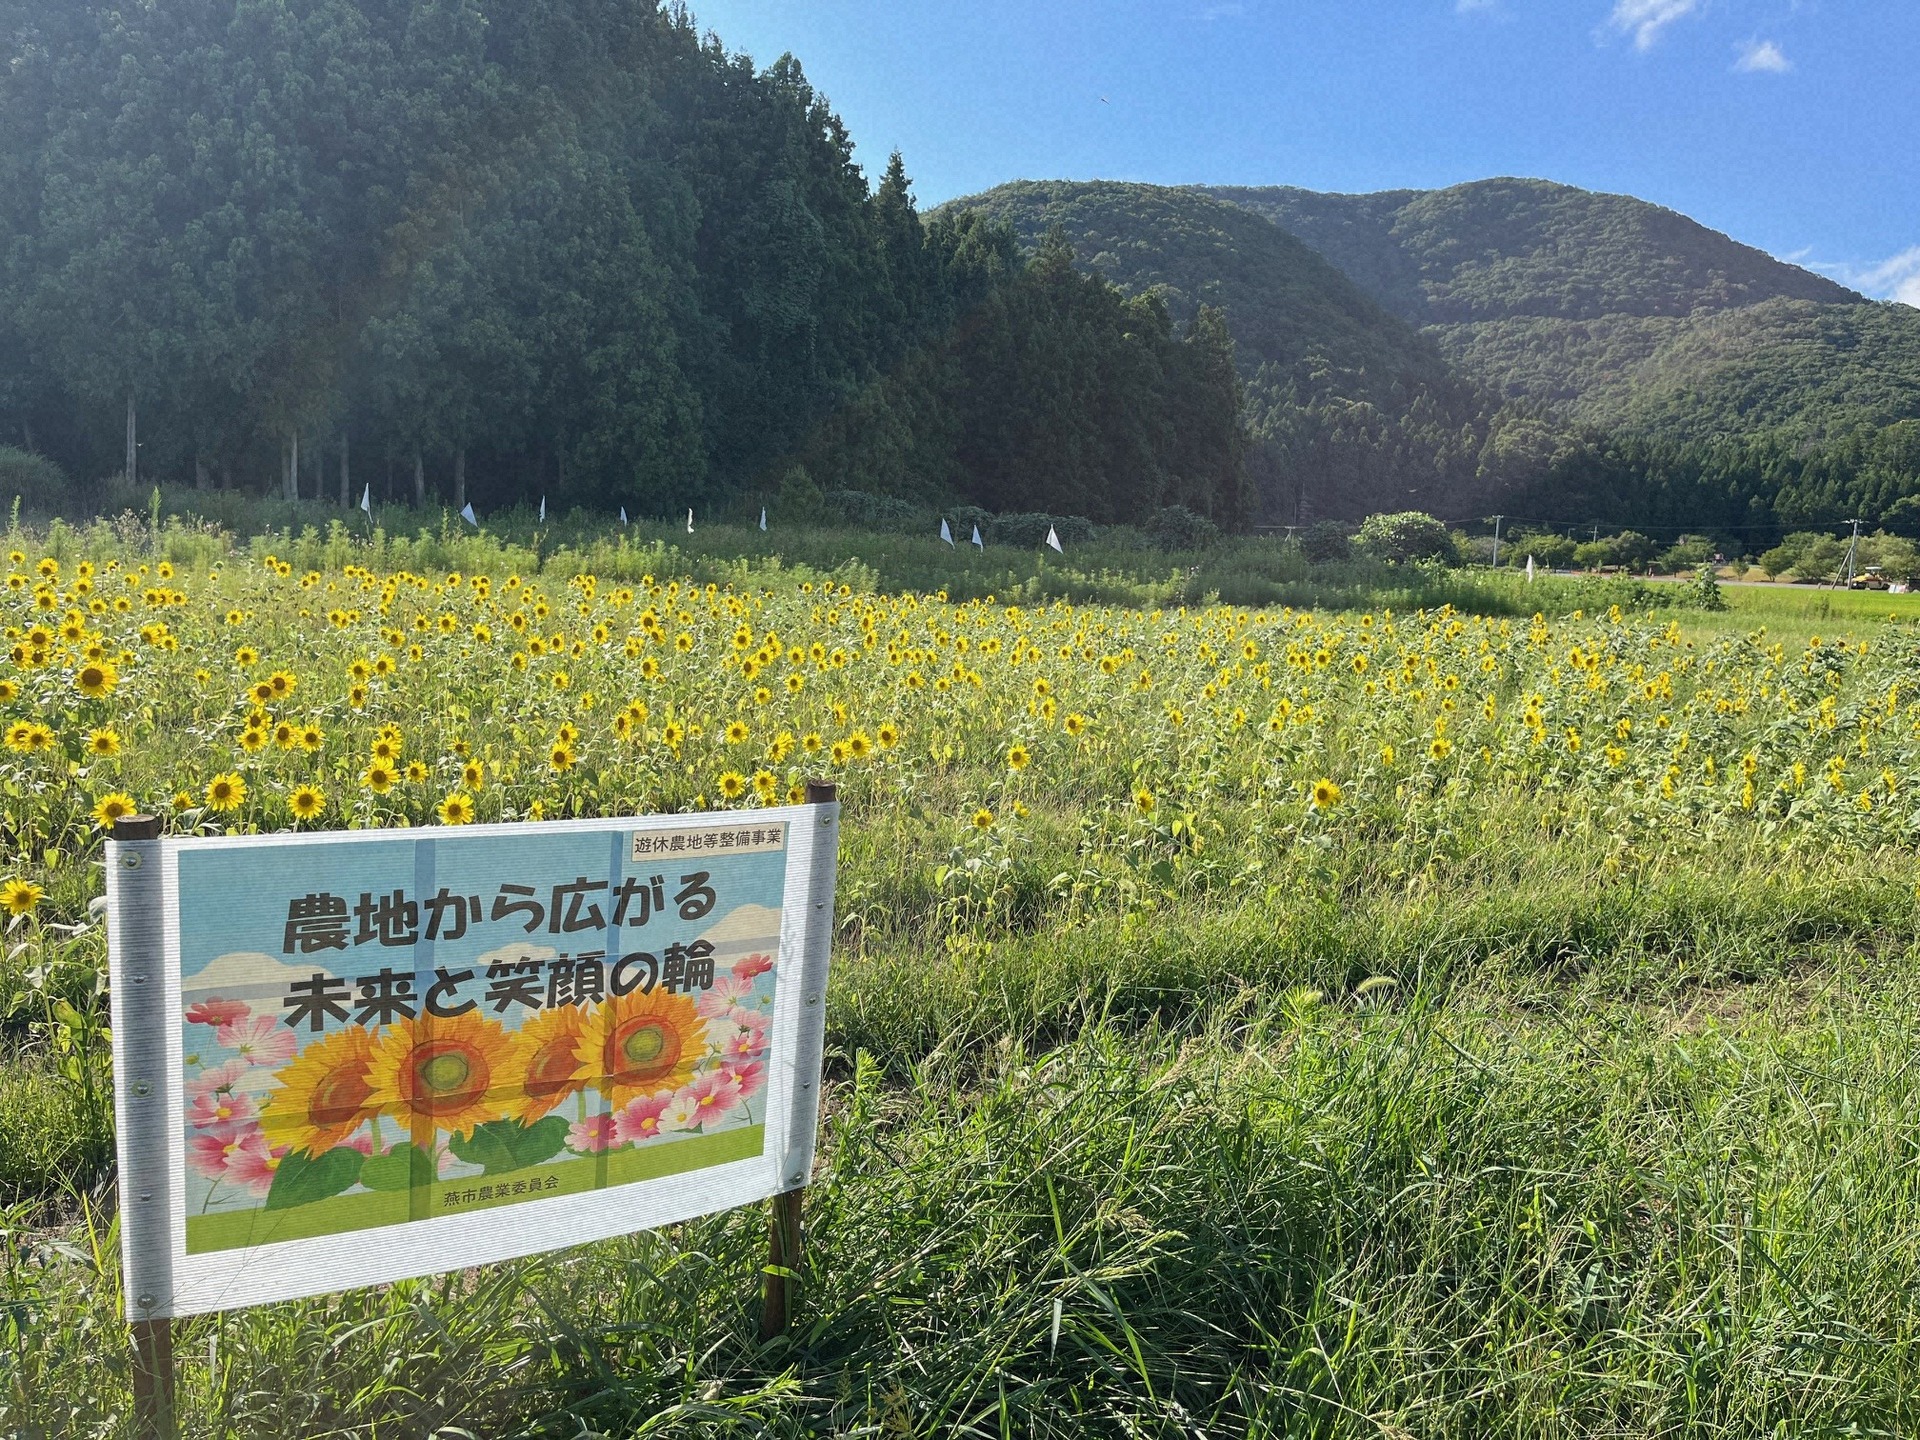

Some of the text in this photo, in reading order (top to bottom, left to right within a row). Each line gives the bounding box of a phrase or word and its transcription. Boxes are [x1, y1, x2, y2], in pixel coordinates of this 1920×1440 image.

[634, 828, 782, 853] 遊休農地等整備事業
[283, 871, 717, 954] 農地から広がる
[283, 939, 716, 1032] 未来と笑顔の輪
[444, 1175, 559, 1207] 燕市農業委員会
